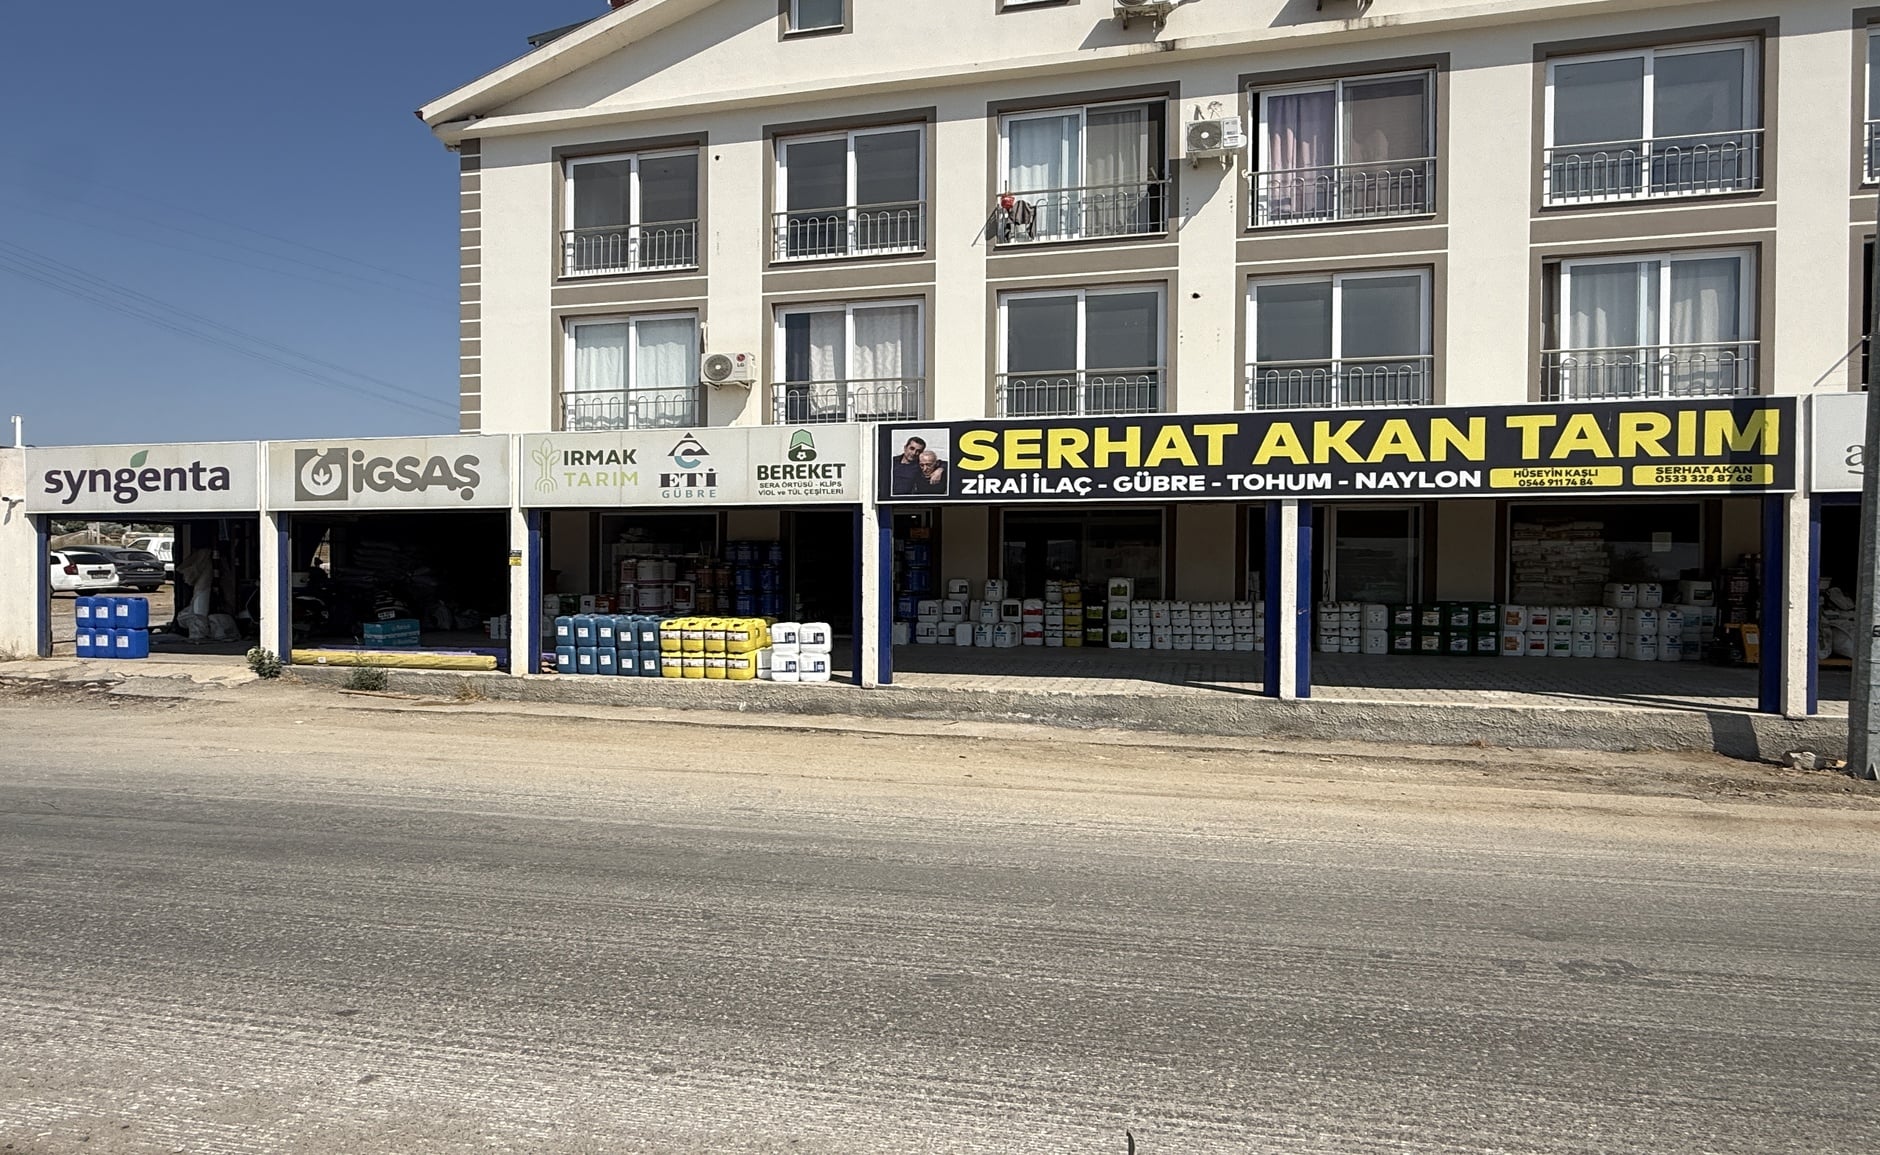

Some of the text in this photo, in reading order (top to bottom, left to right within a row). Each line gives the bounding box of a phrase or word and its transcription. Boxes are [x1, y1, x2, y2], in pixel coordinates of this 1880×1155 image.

[957, 408, 1780, 471] SERHAT AKAN TARIM
[563, 449, 637, 466] IRMAK
[757, 463, 846, 481] BEREKET
[1514, 467, 1599, 478] HÜSEYİN KAŞLI
[1655, 466, 1753, 475] SERHAT AKAN
[44, 460, 231, 505] syngenta
[563, 471, 639, 488] TARIM
[781, 480, 813, 488] ÖRTÜSÜ
[961, 473, 1027, 495] ZİRAİ
[1032, 472, 1092, 496] İLAÇ
[1113, 471, 1206, 492] GÜBRE
[1227, 472, 1332, 491] TOHUM
[1355, 470, 1481, 490] NAYLON
[1518, 479, 1546, 487] 0546
[1548, 479, 1564, 487] 911
[1580, 478, 1594, 486] 84
[1655, 475, 1688, 483] 0533
[1691, 475, 1714, 483] 328
[1736, 474, 1753, 482] 68
[661, 489, 717, 499] GÜBRE
[803, 487, 844, 496] ÇEŞİTLERİ
